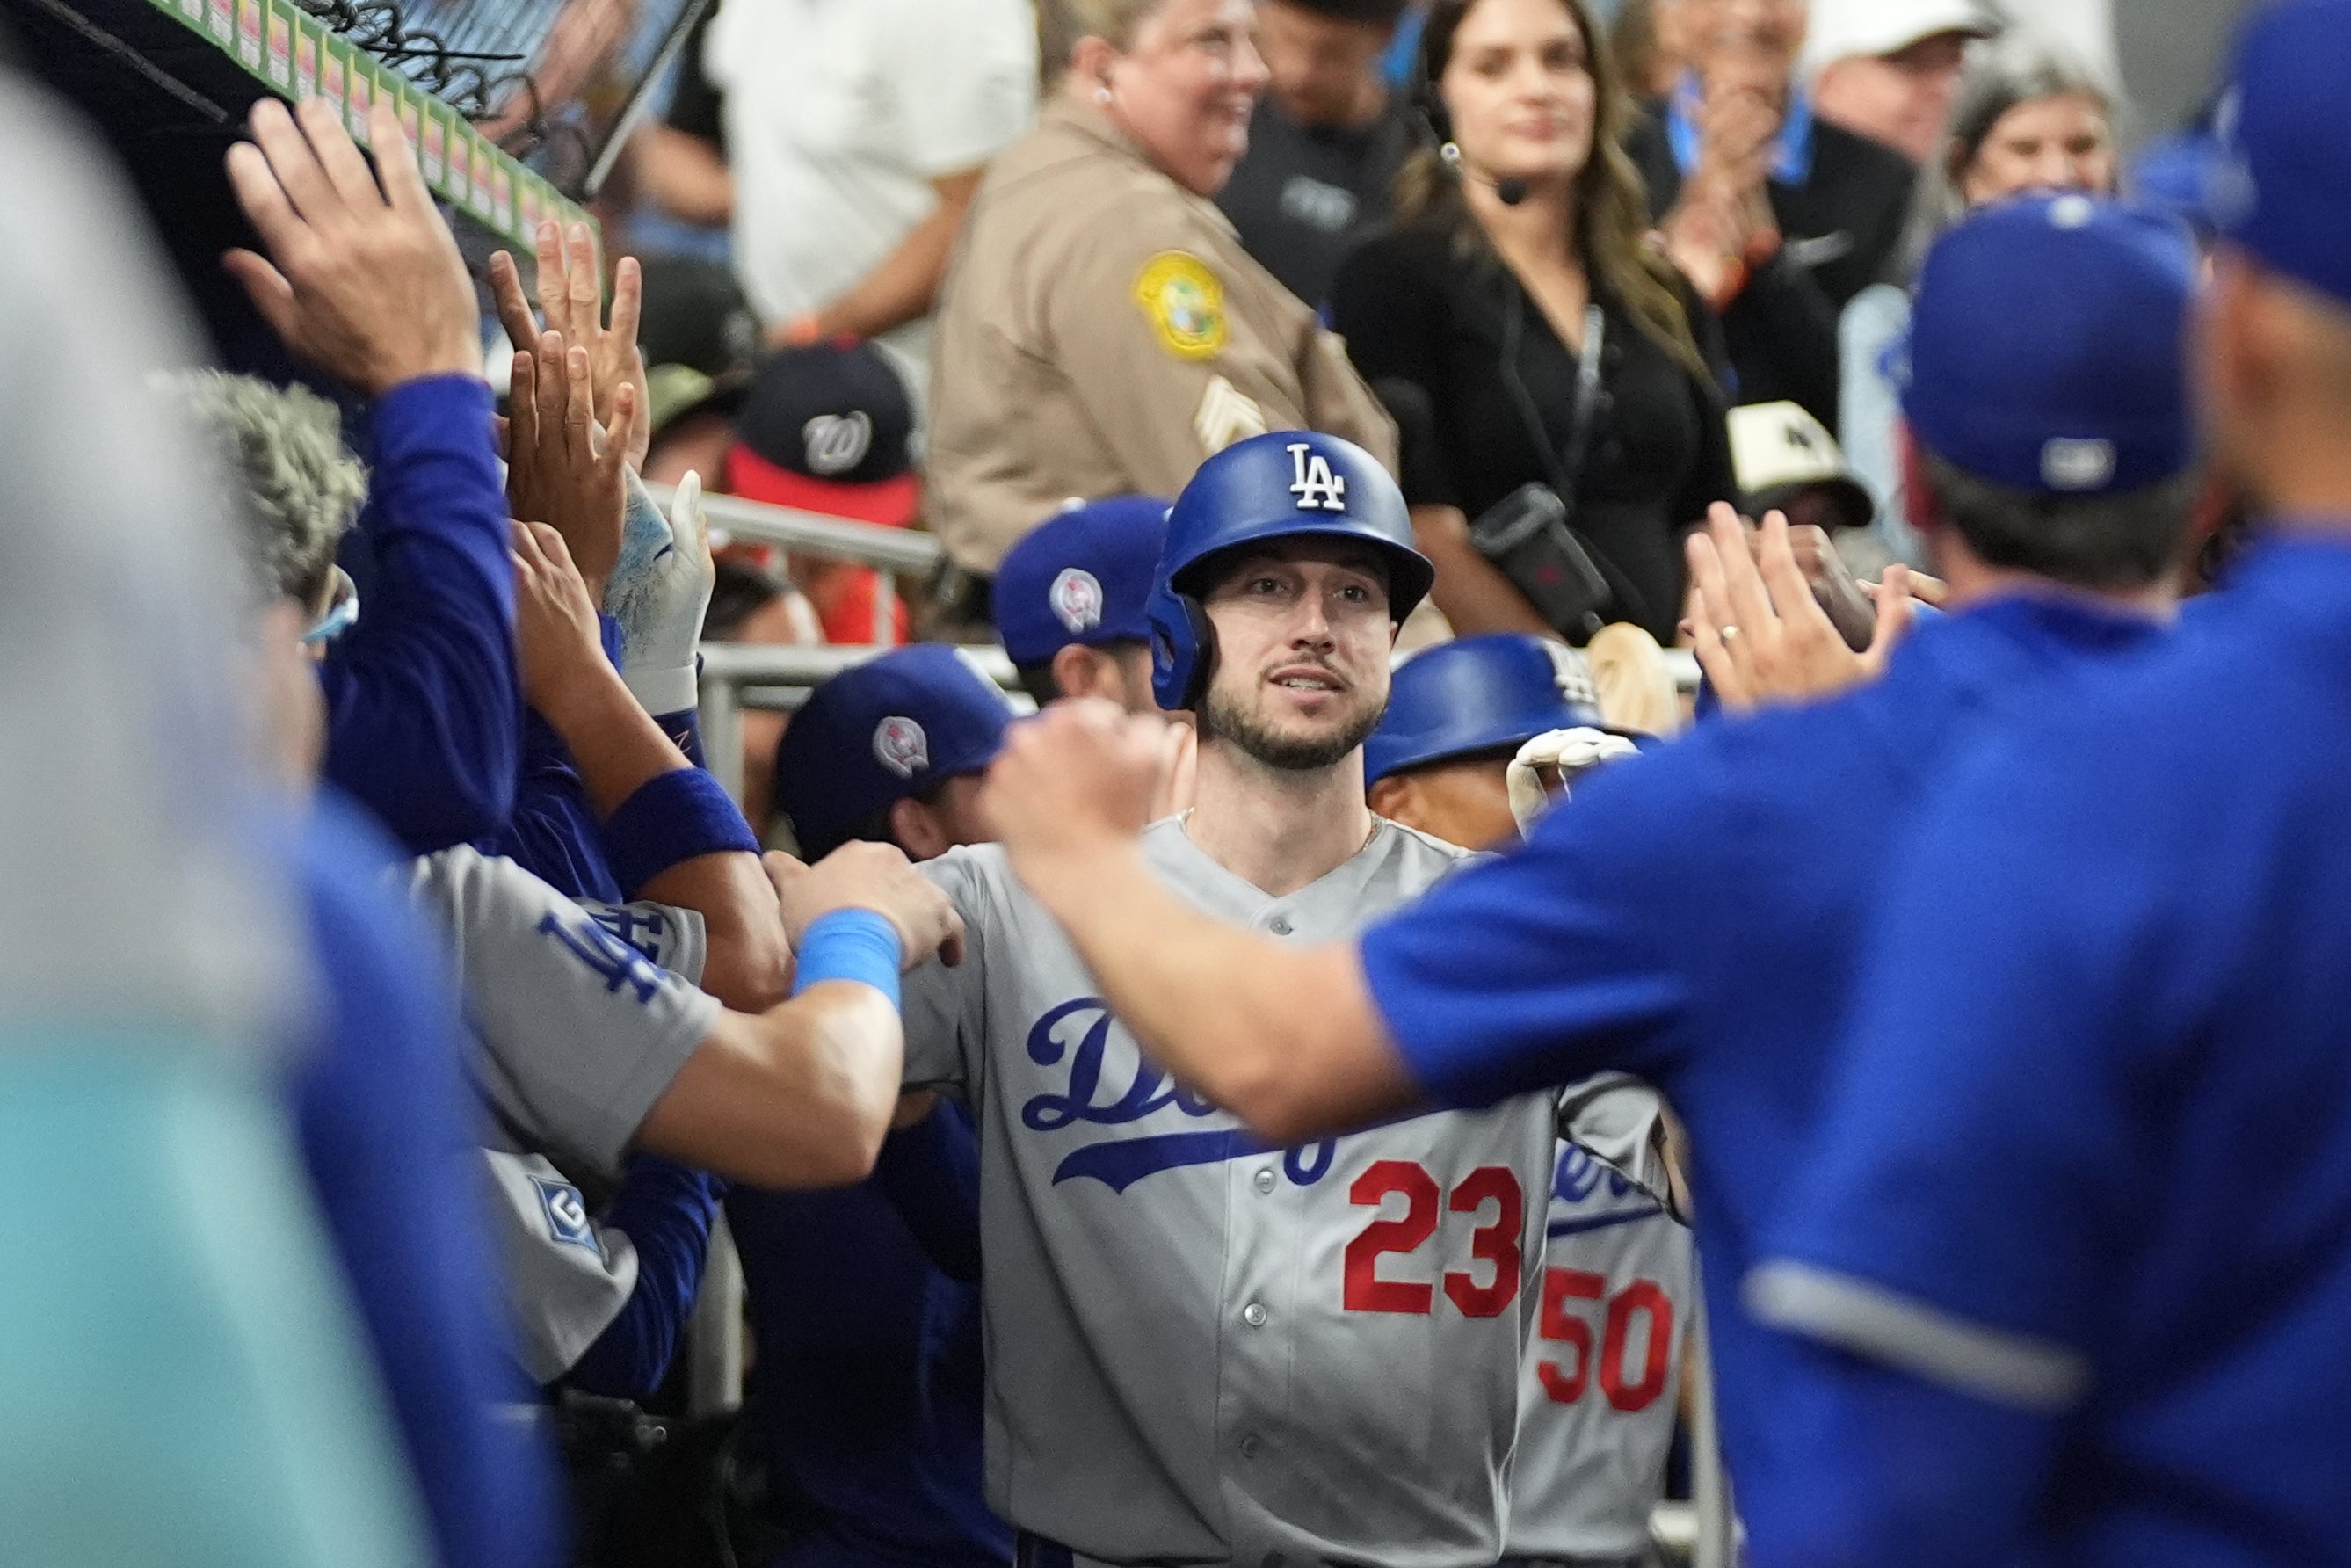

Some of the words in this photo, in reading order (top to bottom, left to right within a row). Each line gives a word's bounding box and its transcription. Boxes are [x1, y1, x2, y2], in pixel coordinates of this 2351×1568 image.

[801, 410, 873, 475] W
[1287, 443, 1345, 510] LA
[1343, 1159, 1522, 1318] 23
[1536, 1266, 1673, 1412] 50
